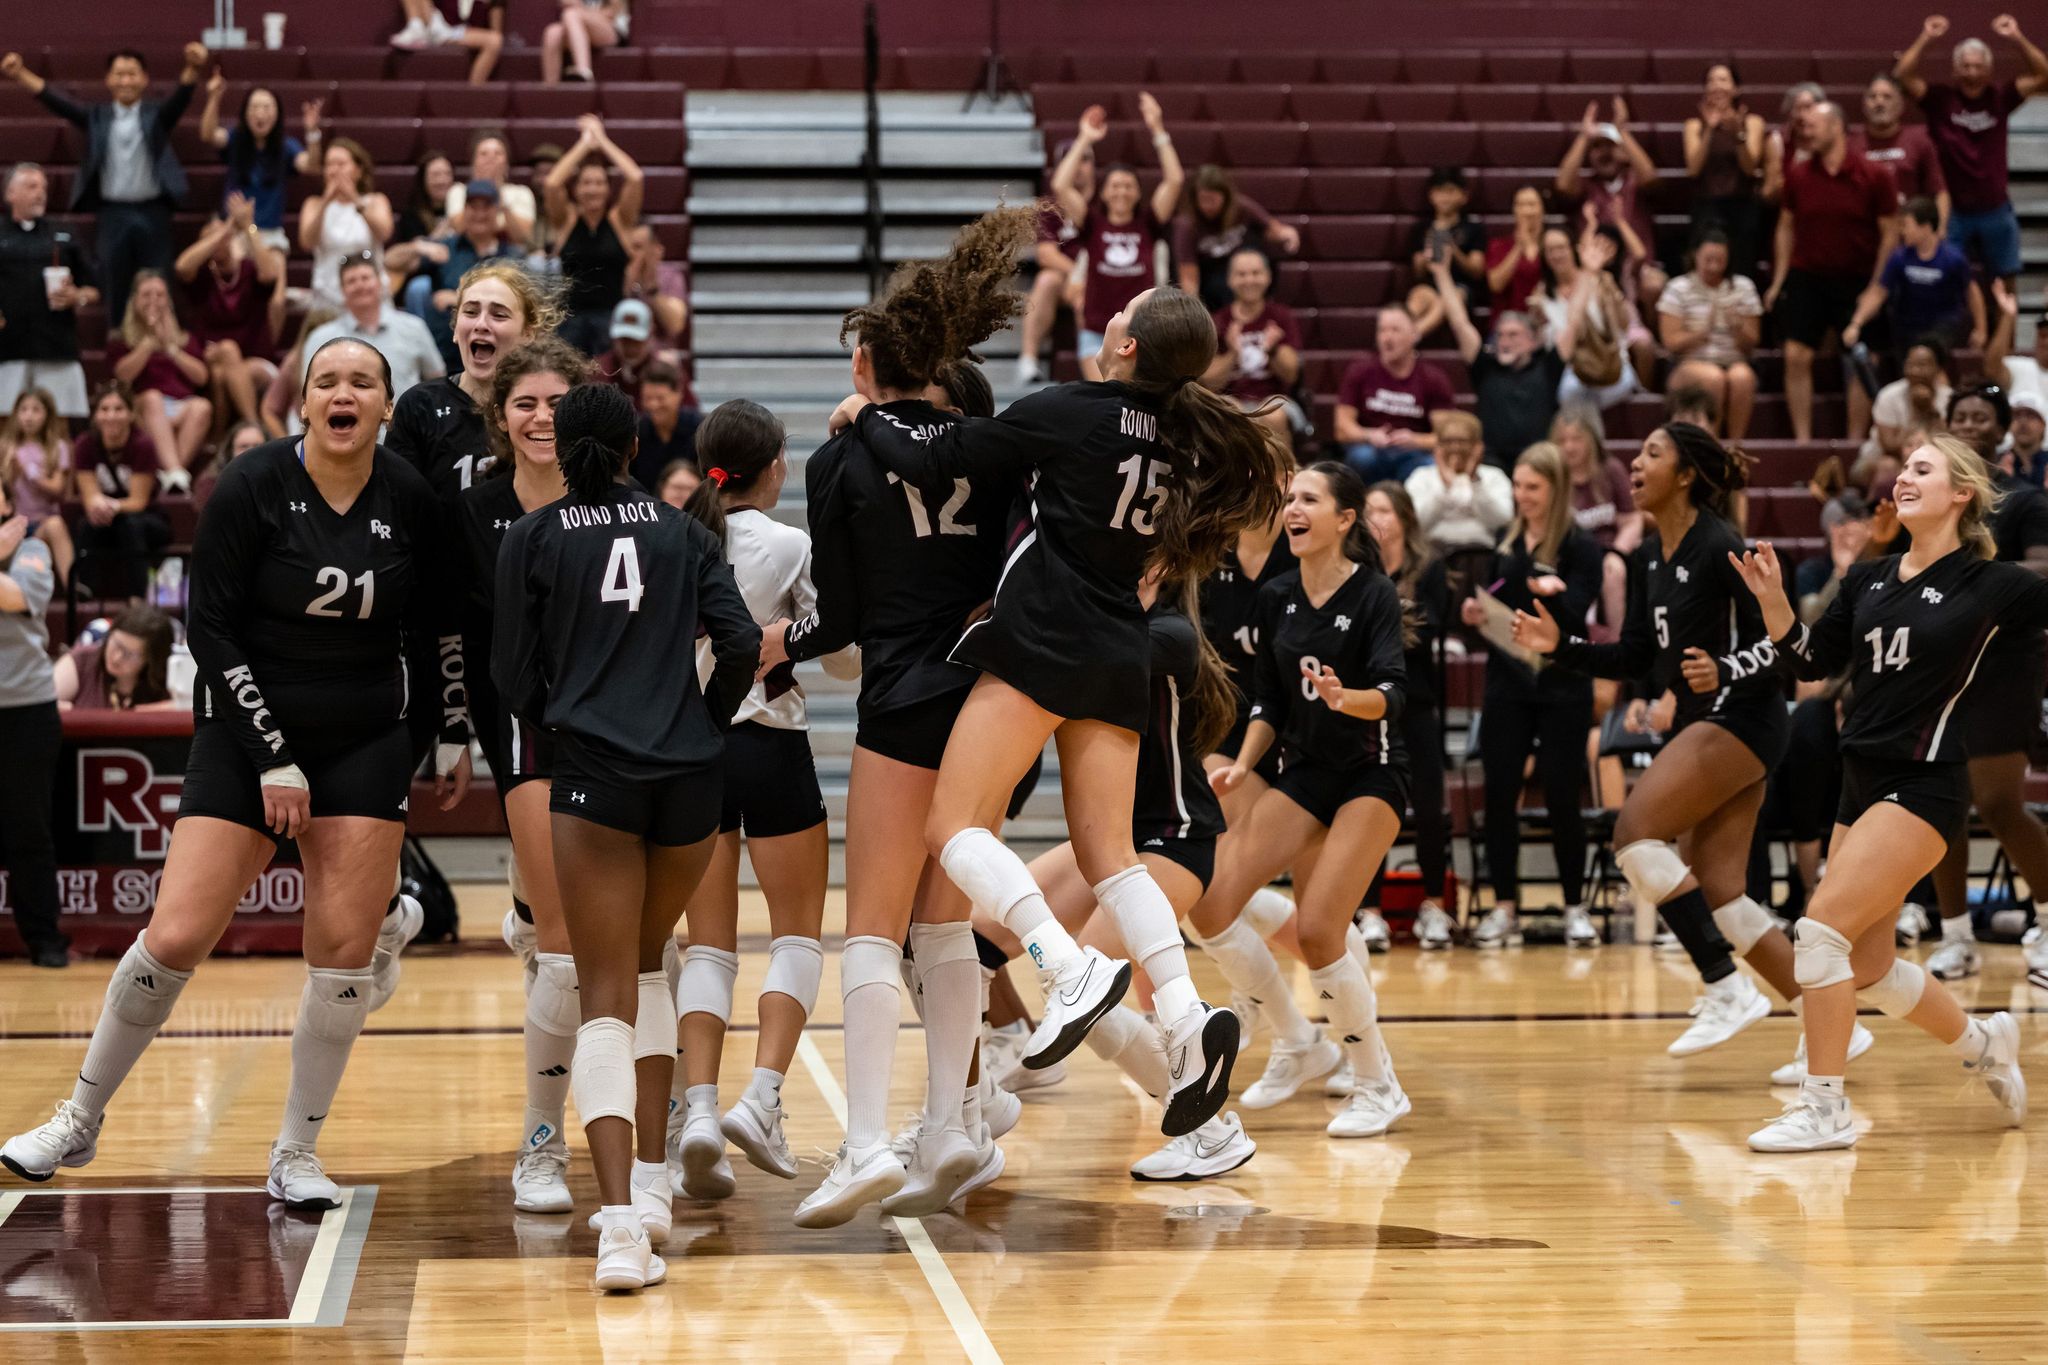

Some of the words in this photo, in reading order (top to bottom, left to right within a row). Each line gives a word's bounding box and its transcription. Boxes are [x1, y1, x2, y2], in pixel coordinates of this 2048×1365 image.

[1120, 407, 1156, 442] ROUND
[559, 504, 612, 530] ROUND
[616, 501, 660, 525] ROCK
[886, 470, 978, 538] 12
[1109, 453, 1174, 536] 15
[370, 518, 392, 540] RR
[305, 566, 375, 620] 21
[600, 536, 645, 613] 4
[1653, 605, 1670, 649] 5
[1864, 626, 1911, 674] 14
[438, 633, 469, 729] ROCK
[1299, 655, 1322, 702] 8
[222, 663, 287, 755] ROCK
